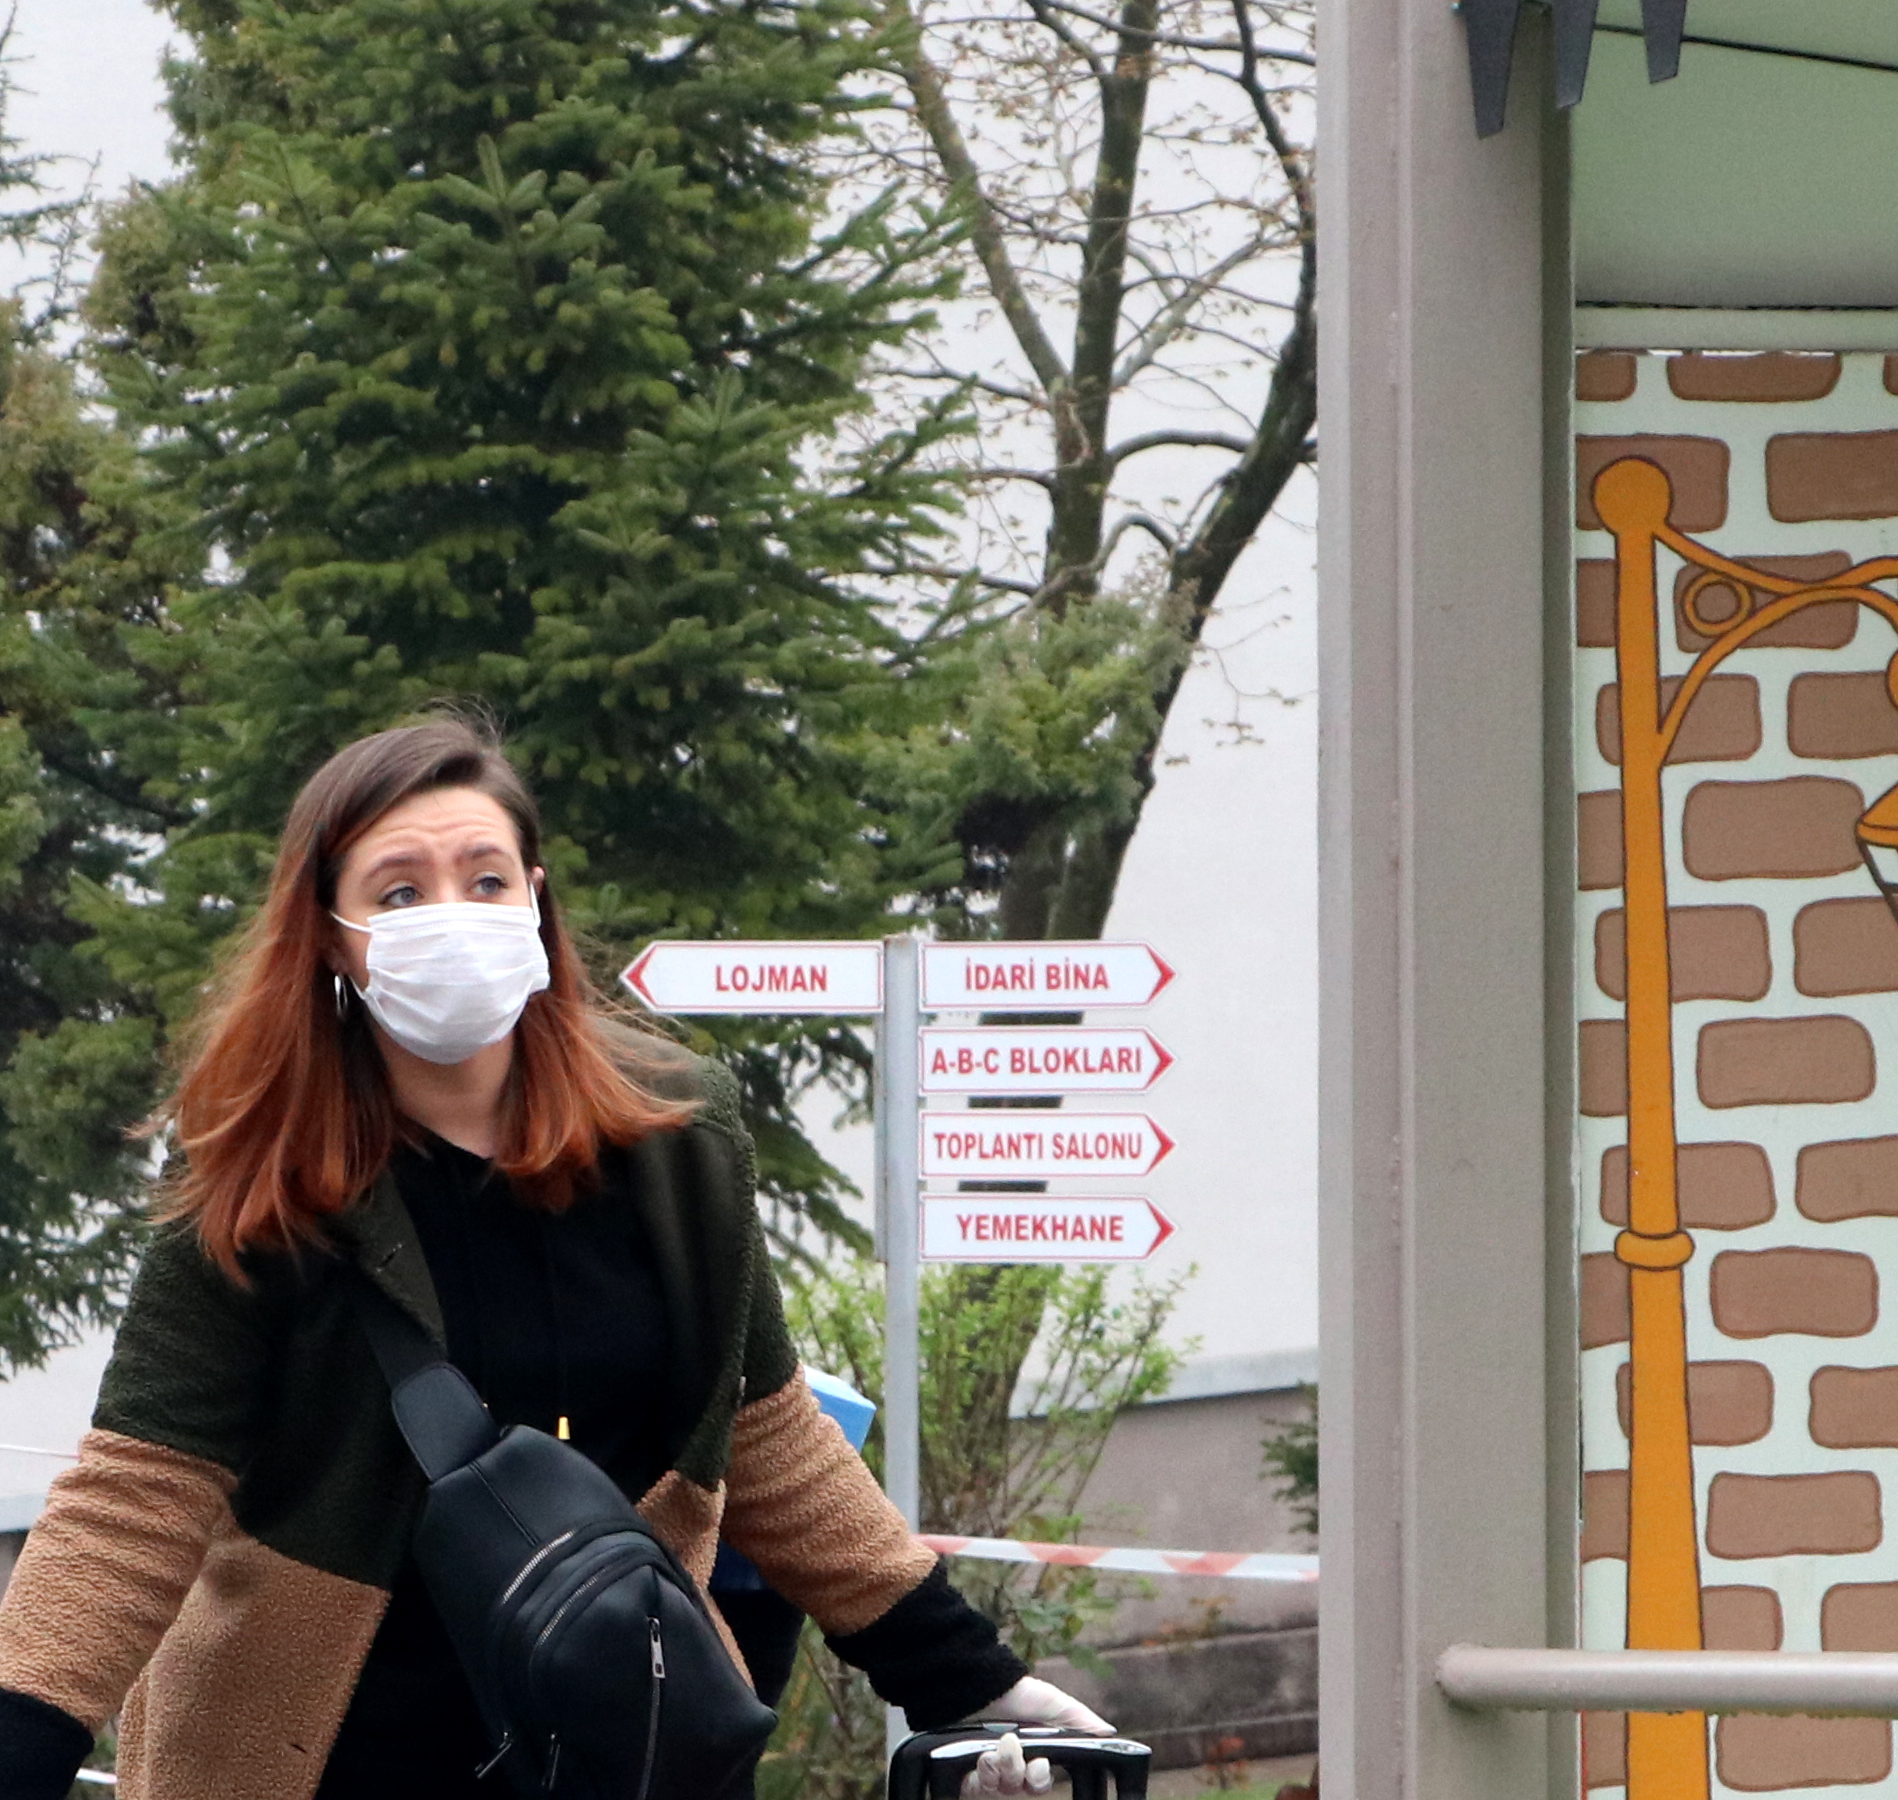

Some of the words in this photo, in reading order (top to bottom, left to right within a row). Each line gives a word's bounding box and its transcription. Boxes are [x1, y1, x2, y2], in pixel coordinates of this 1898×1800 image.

[715, 964, 828, 992] LOJMAN
[964, 957, 1035, 991] İDARİ
[1045, 957, 1110, 991] BİNA
[931, 1047, 1000, 1075] A-B-C
[1009, 1046, 1142, 1074] BLOKLARI
[933, 1132, 1043, 1160] TOPLANTI
[1052, 1132, 1143, 1160] SALONU
[956, 1214, 1125, 1242] YEMEKHANE
